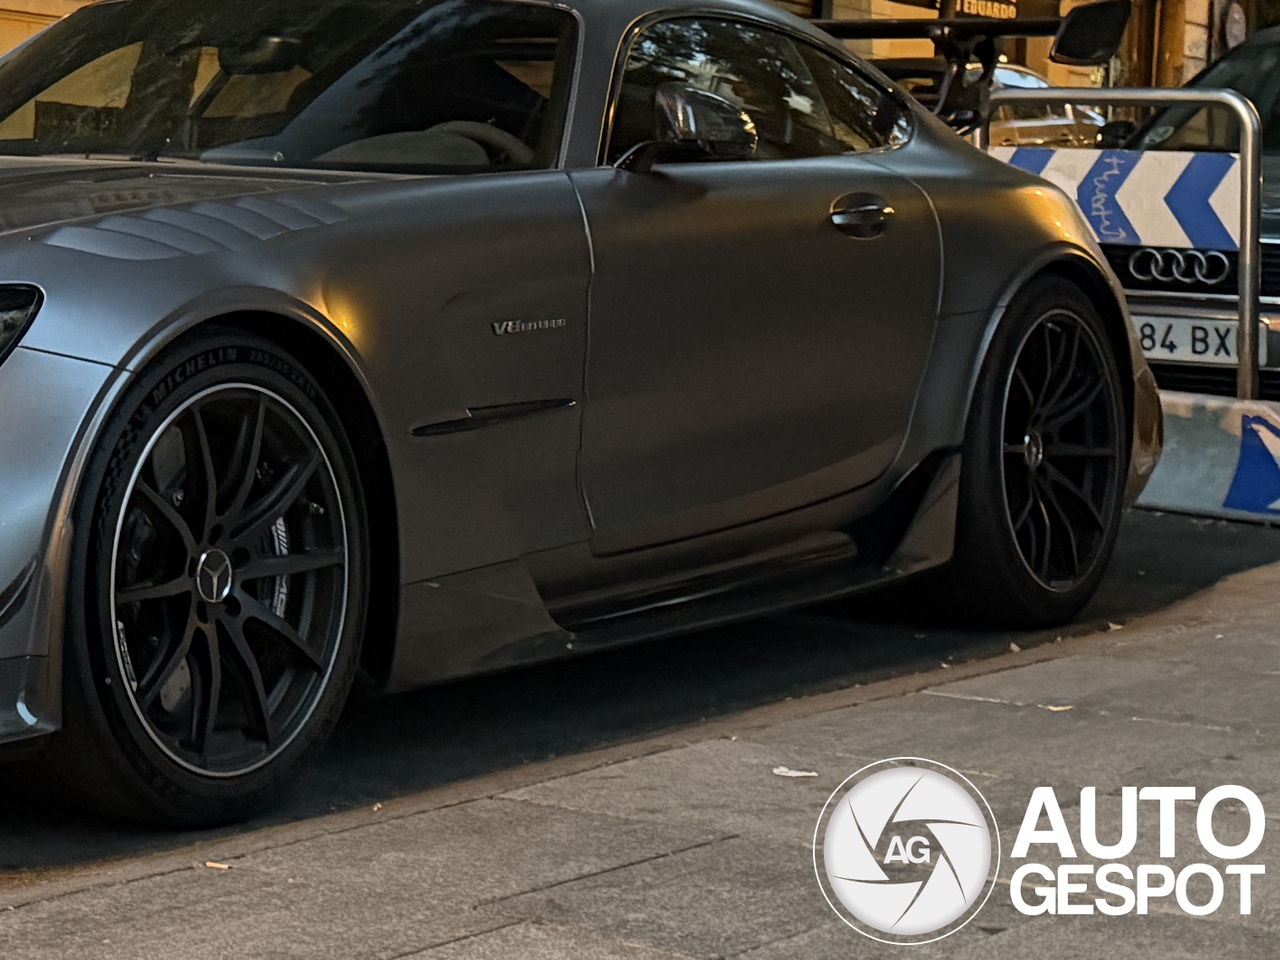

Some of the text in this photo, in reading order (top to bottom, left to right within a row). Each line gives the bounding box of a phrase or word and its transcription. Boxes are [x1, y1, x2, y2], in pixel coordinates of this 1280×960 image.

[1140, 323, 1231, 357] 84 BX
[152, 347, 238, 405] MICHELIN
